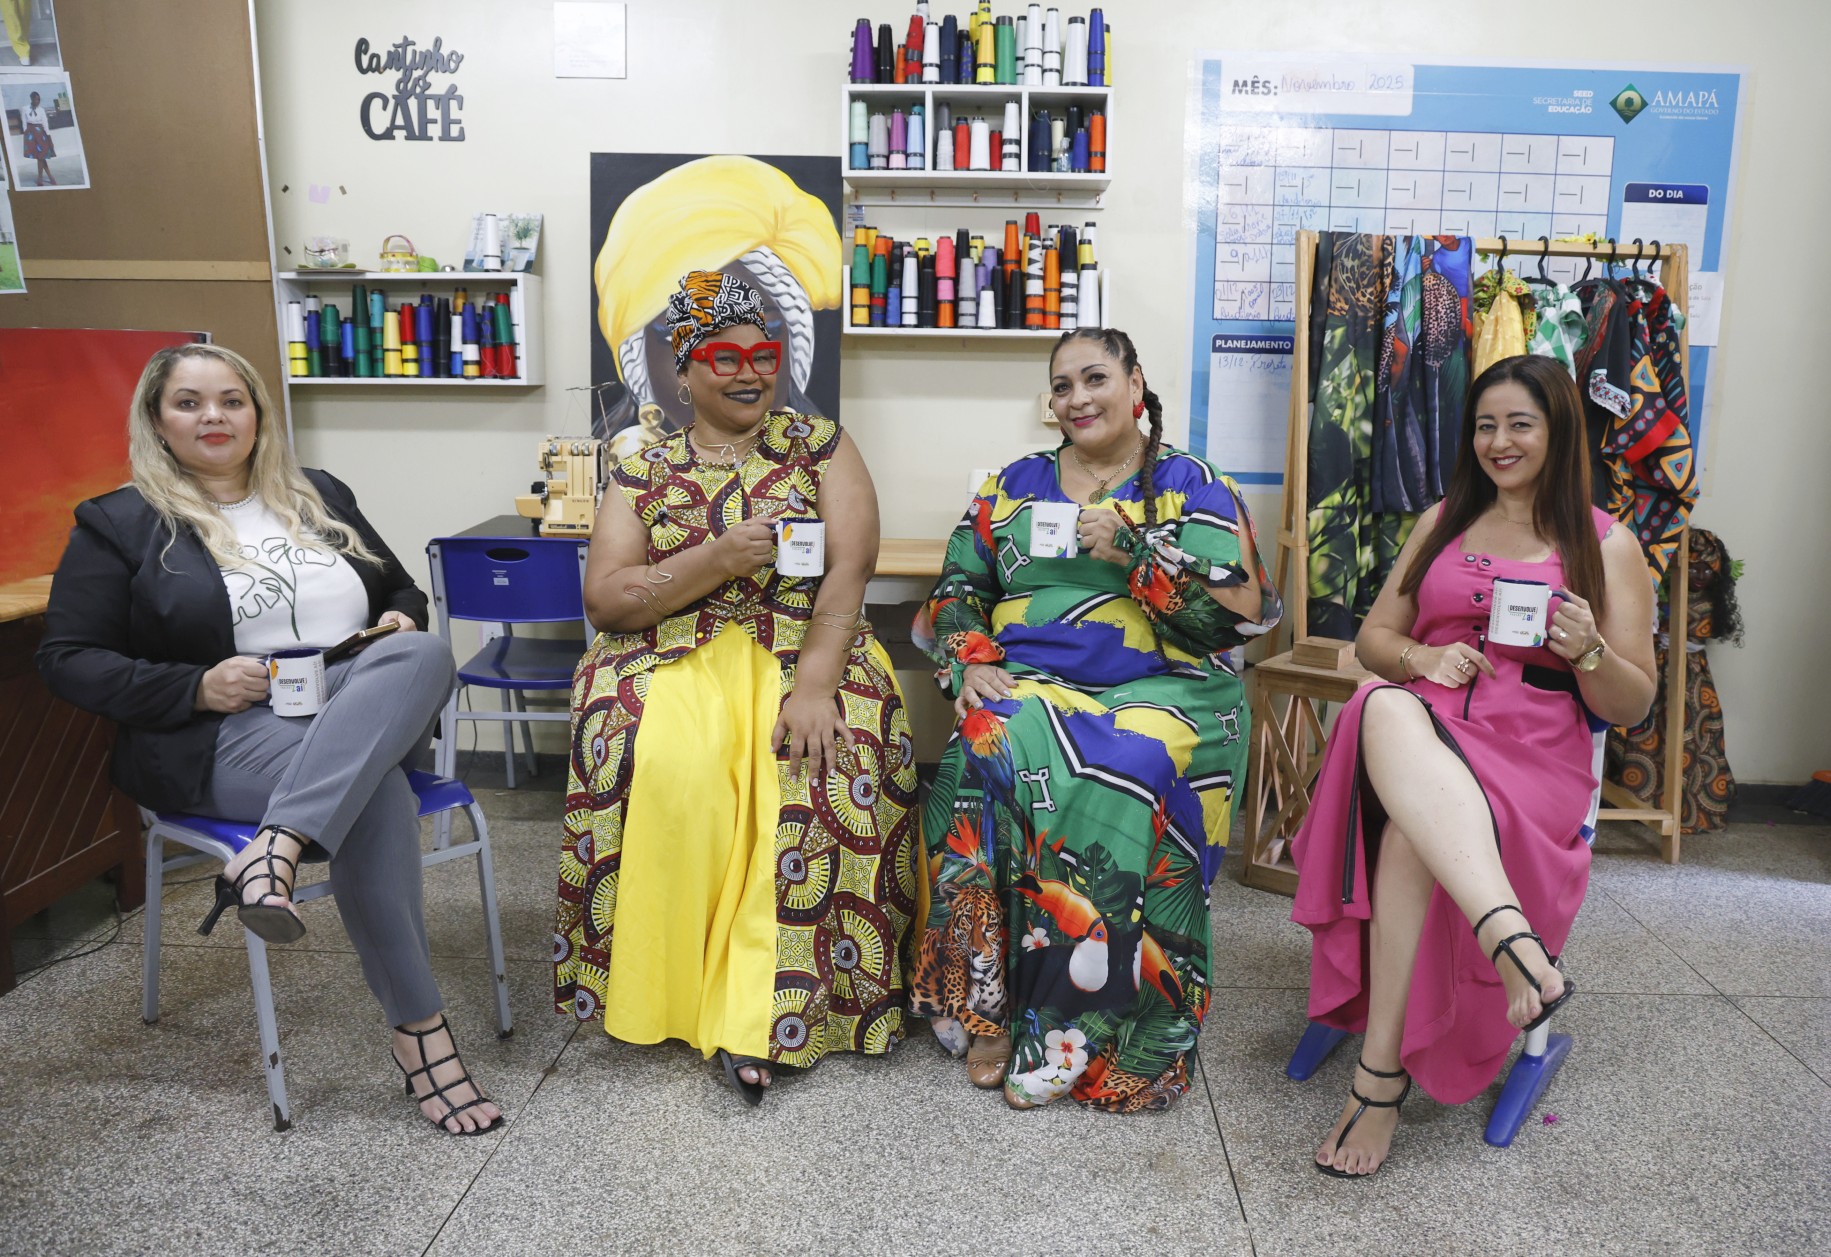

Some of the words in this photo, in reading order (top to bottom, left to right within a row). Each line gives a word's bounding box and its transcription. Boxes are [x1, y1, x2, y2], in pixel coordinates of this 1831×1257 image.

[354, 35, 464, 75] Cantinho
[1231, 75, 1278, 96] MÊS:
[1369, 73, 1405, 90] 2025
[1573, 90, 1594, 98] SEED
[1651, 88, 1719, 108] AMAPÁ
[1532, 97, 1580, 106] SECRETARIA
[1582, 98, 1593, 106] DE
[360, 84, 466, 142] CAFÉ
[1548, 105, 1593, 115] EDUCAÇÃO
[1648, 189, 1664, 198] DO
[1666, 190, 1684, 199] DIA
[1215, 339, 1291, 349] PLANEJAMENTO
